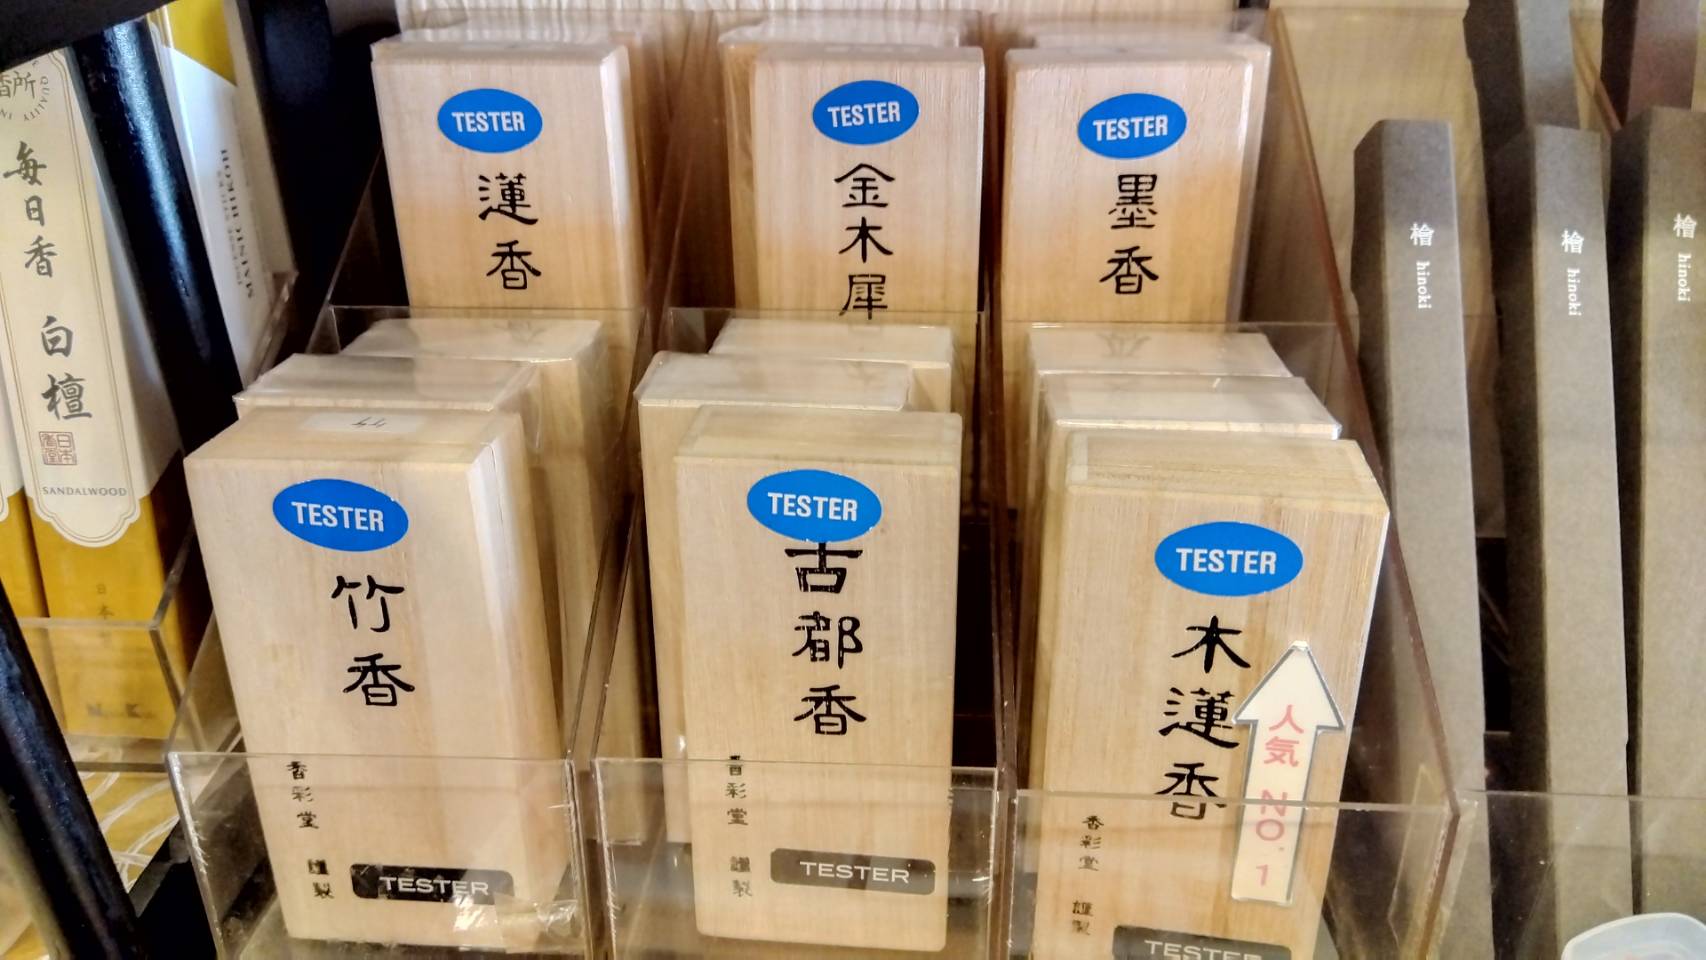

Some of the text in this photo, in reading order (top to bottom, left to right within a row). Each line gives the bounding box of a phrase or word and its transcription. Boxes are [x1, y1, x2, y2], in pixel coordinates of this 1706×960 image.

[452, 111, 525, 132] TESTER
[827, 101, 901, 128] TESTER
[1093, 115, 1169, 142] TESTER
[478, 172, 542, 290] 蓮香
[834, 163, 895, 320] 金木犀
[1099, 173, 1159, 295] 墨香
[1673, 213, 1698, 302] 檜 hinoki
[1410, 223, 1435, 309] 檜 hinoki
[1561, 229, 1585, 316] 檜 hinoki
[41, 316, 92, 420] 白檀
[42, 486, 127, 497] SANDALWOOD
[291, 501, 385, 532] TESTER
[767, 491, 859, 522] TESTER
[1175, 548, 1277, 575] TESTER
[331, 575, 416, 707] 竹香
[784, 541, 867, 736] 古都香
[1154, 615, 1252, 820] 木蓮香
[1263, 704, 1304, 767] 人気
[379, 876, 489, 896] TESTER
[800, 860, 910, 884] TESTER
[1256, 864, 1268, 886] 1
